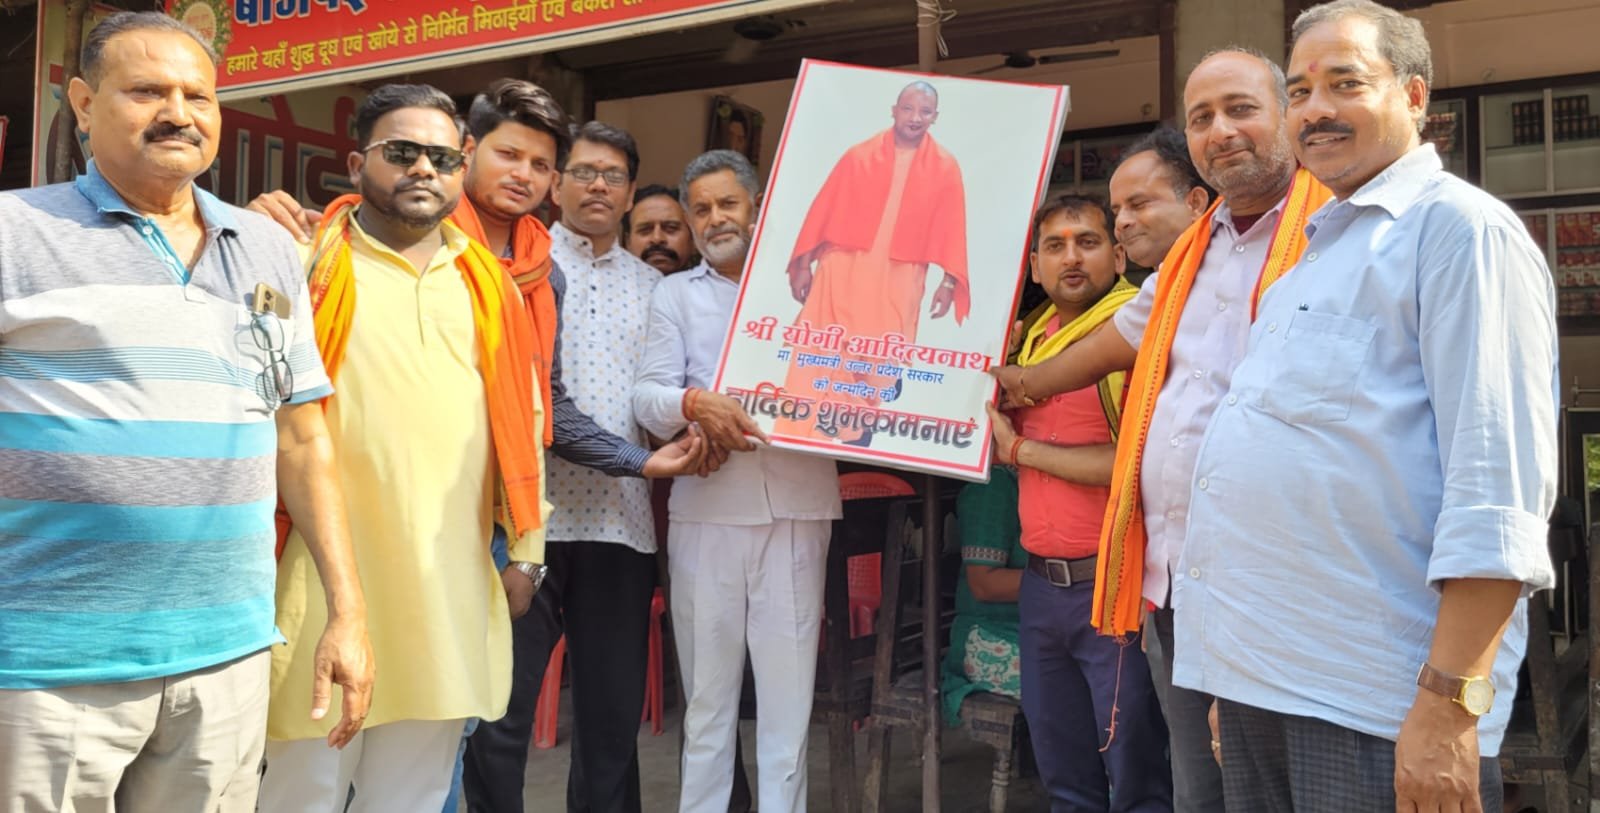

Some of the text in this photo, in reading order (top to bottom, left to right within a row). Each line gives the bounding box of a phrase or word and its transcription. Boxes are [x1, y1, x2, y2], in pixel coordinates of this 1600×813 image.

[227, 46, 258, 75] हमारे
[290, 43, 315, 71] शुद्ध
[343, 28, 364, 55] एवं
[368, 20, 399, 50] खोये
[403, 17, 418, 44] से
[422, 8, 469, 41] निर्मित
[744, 316, 993, 373] श्री योगी आदित्यनाथ
[907, 369, 944, 384] सरकार
